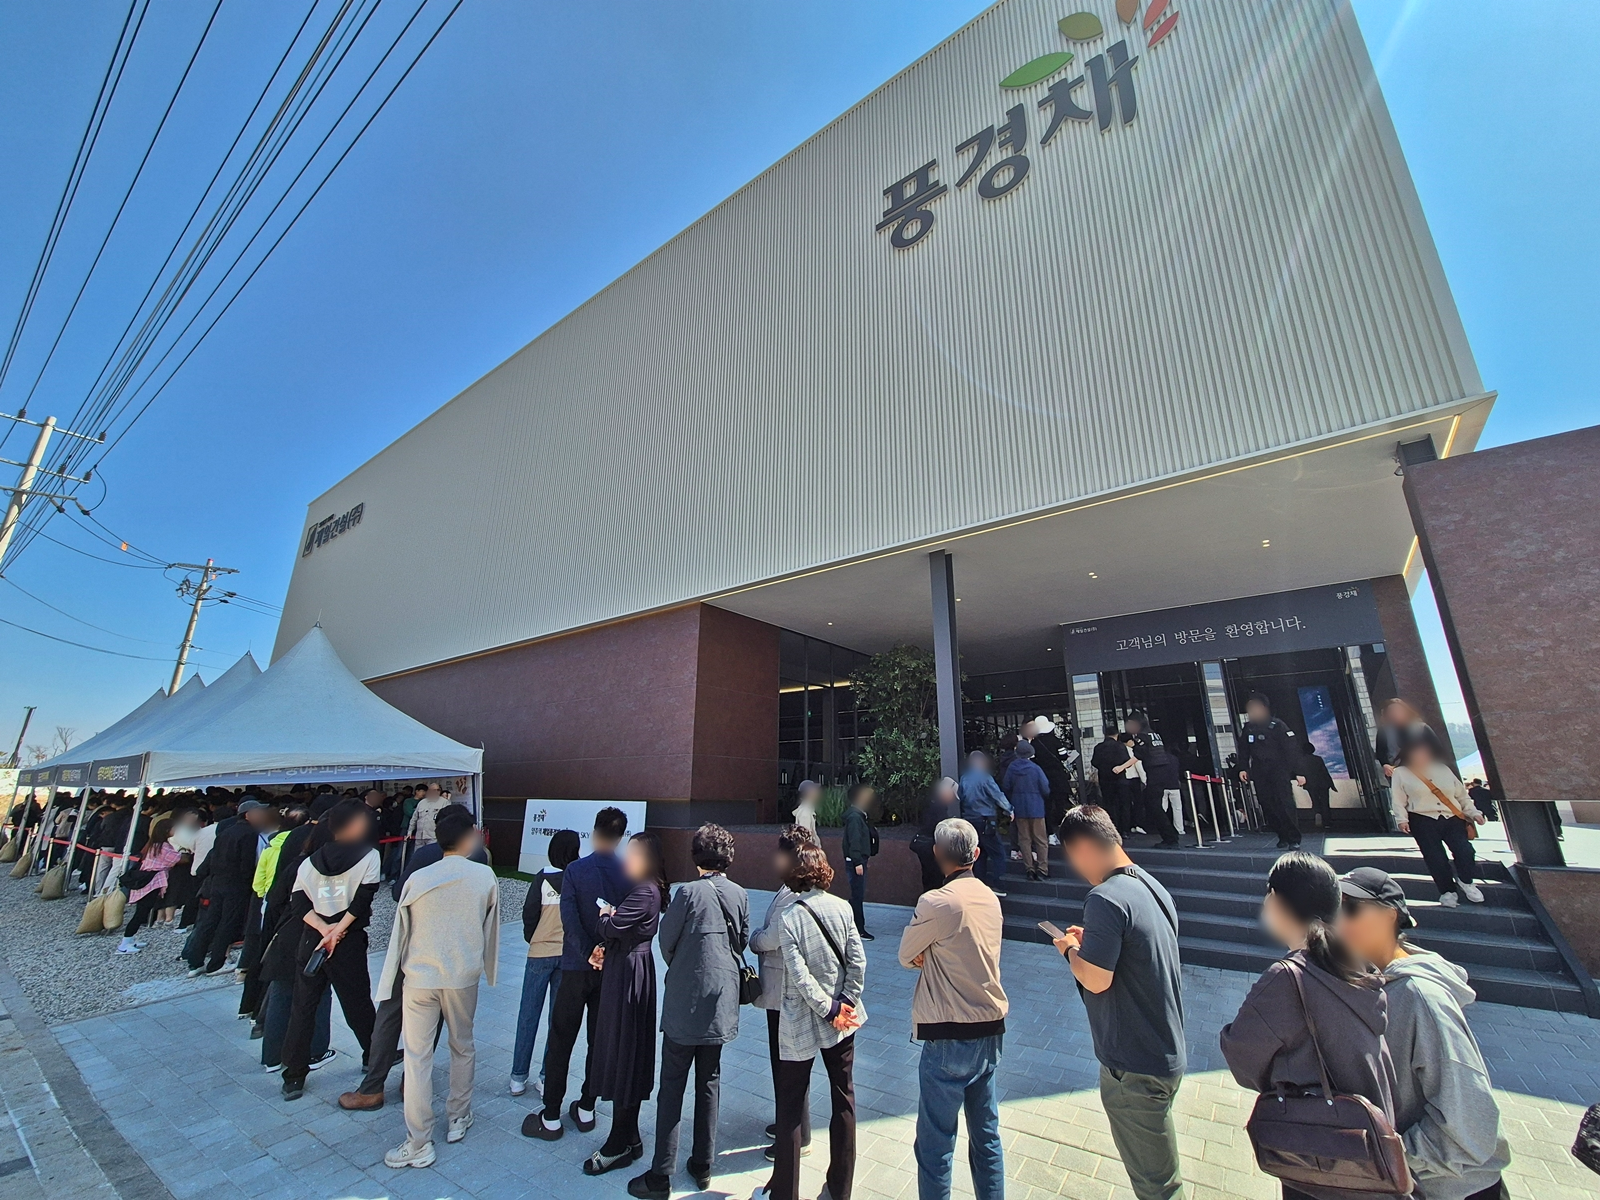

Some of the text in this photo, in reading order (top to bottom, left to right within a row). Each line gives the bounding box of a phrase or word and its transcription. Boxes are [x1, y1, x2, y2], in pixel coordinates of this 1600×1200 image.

[875, 39, 1139, 250] 풍경채
[1336, 589, 1358, 600] 풍경채
[1116, 615, 1306, 651] 고객님의 방문을 환영합니다.
